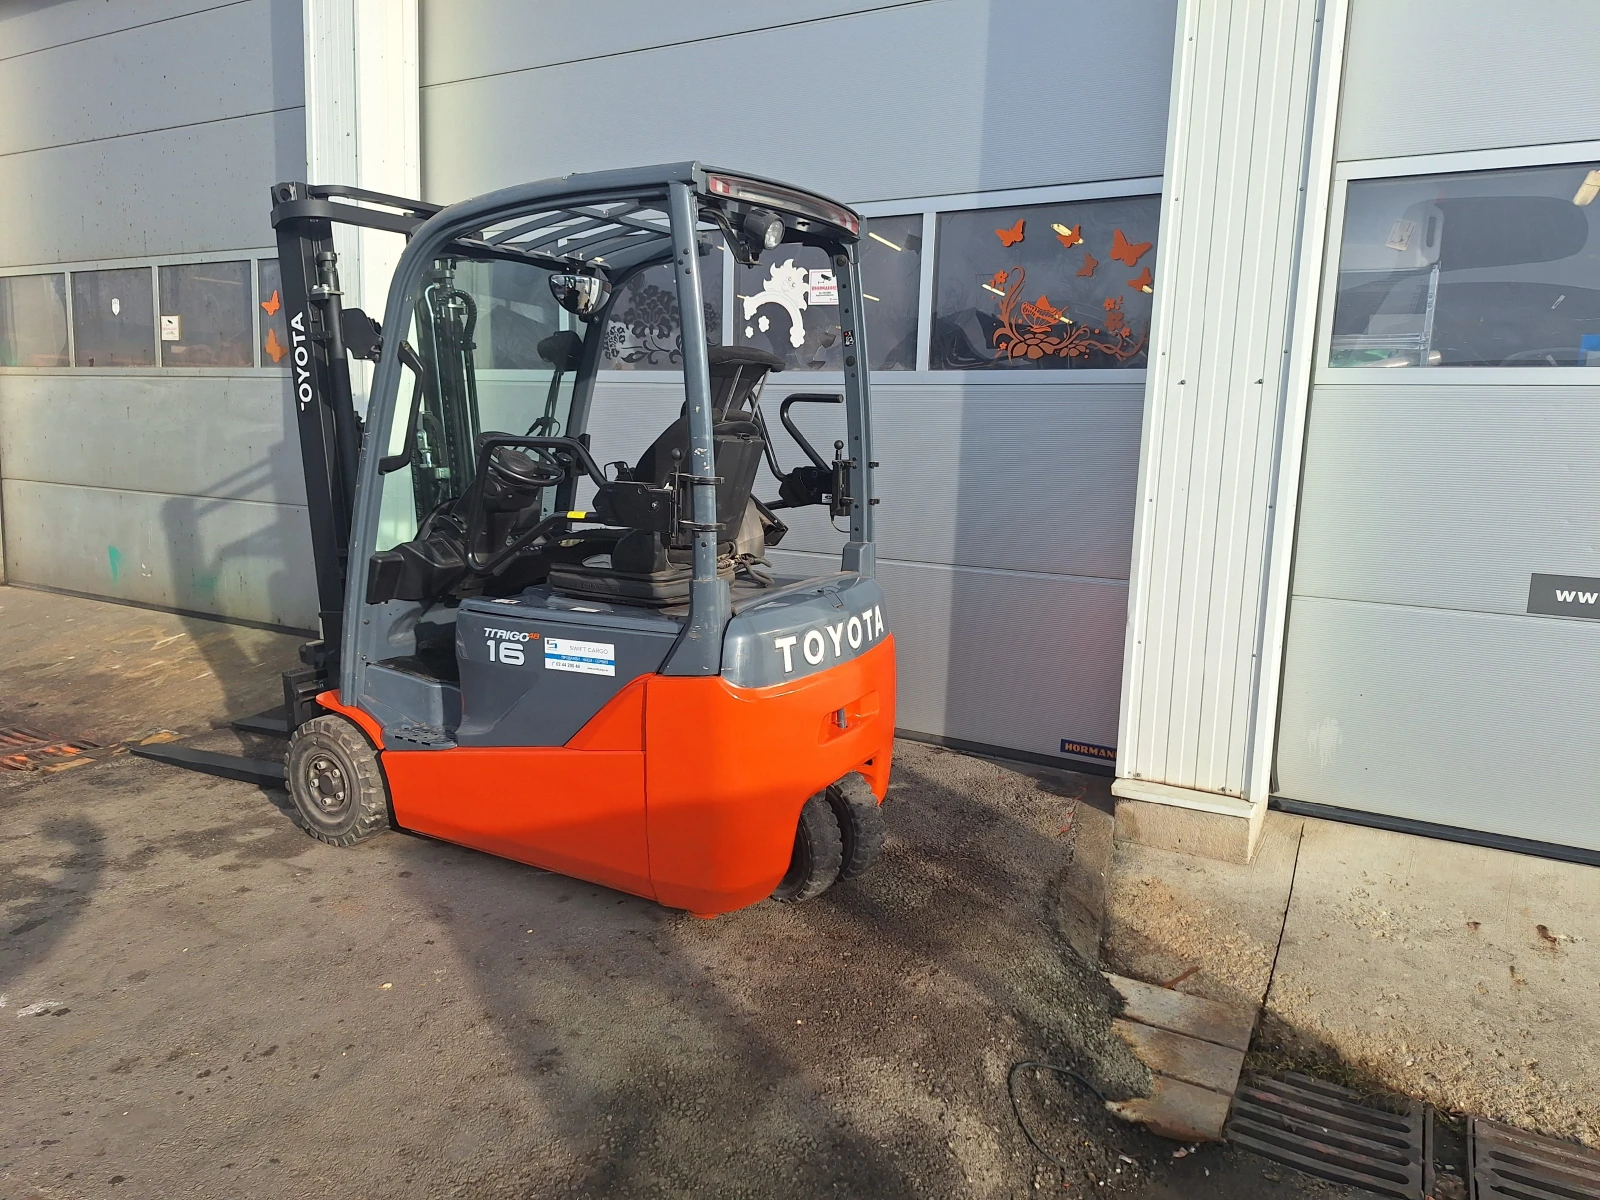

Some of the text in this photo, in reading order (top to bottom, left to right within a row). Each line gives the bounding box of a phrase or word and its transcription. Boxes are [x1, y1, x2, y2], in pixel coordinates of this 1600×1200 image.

[569, 645, 609, 655] SWIFT CARGO
[774, 604, 885, 673] TOYOTA
[486, 639, 525, 666] 16
